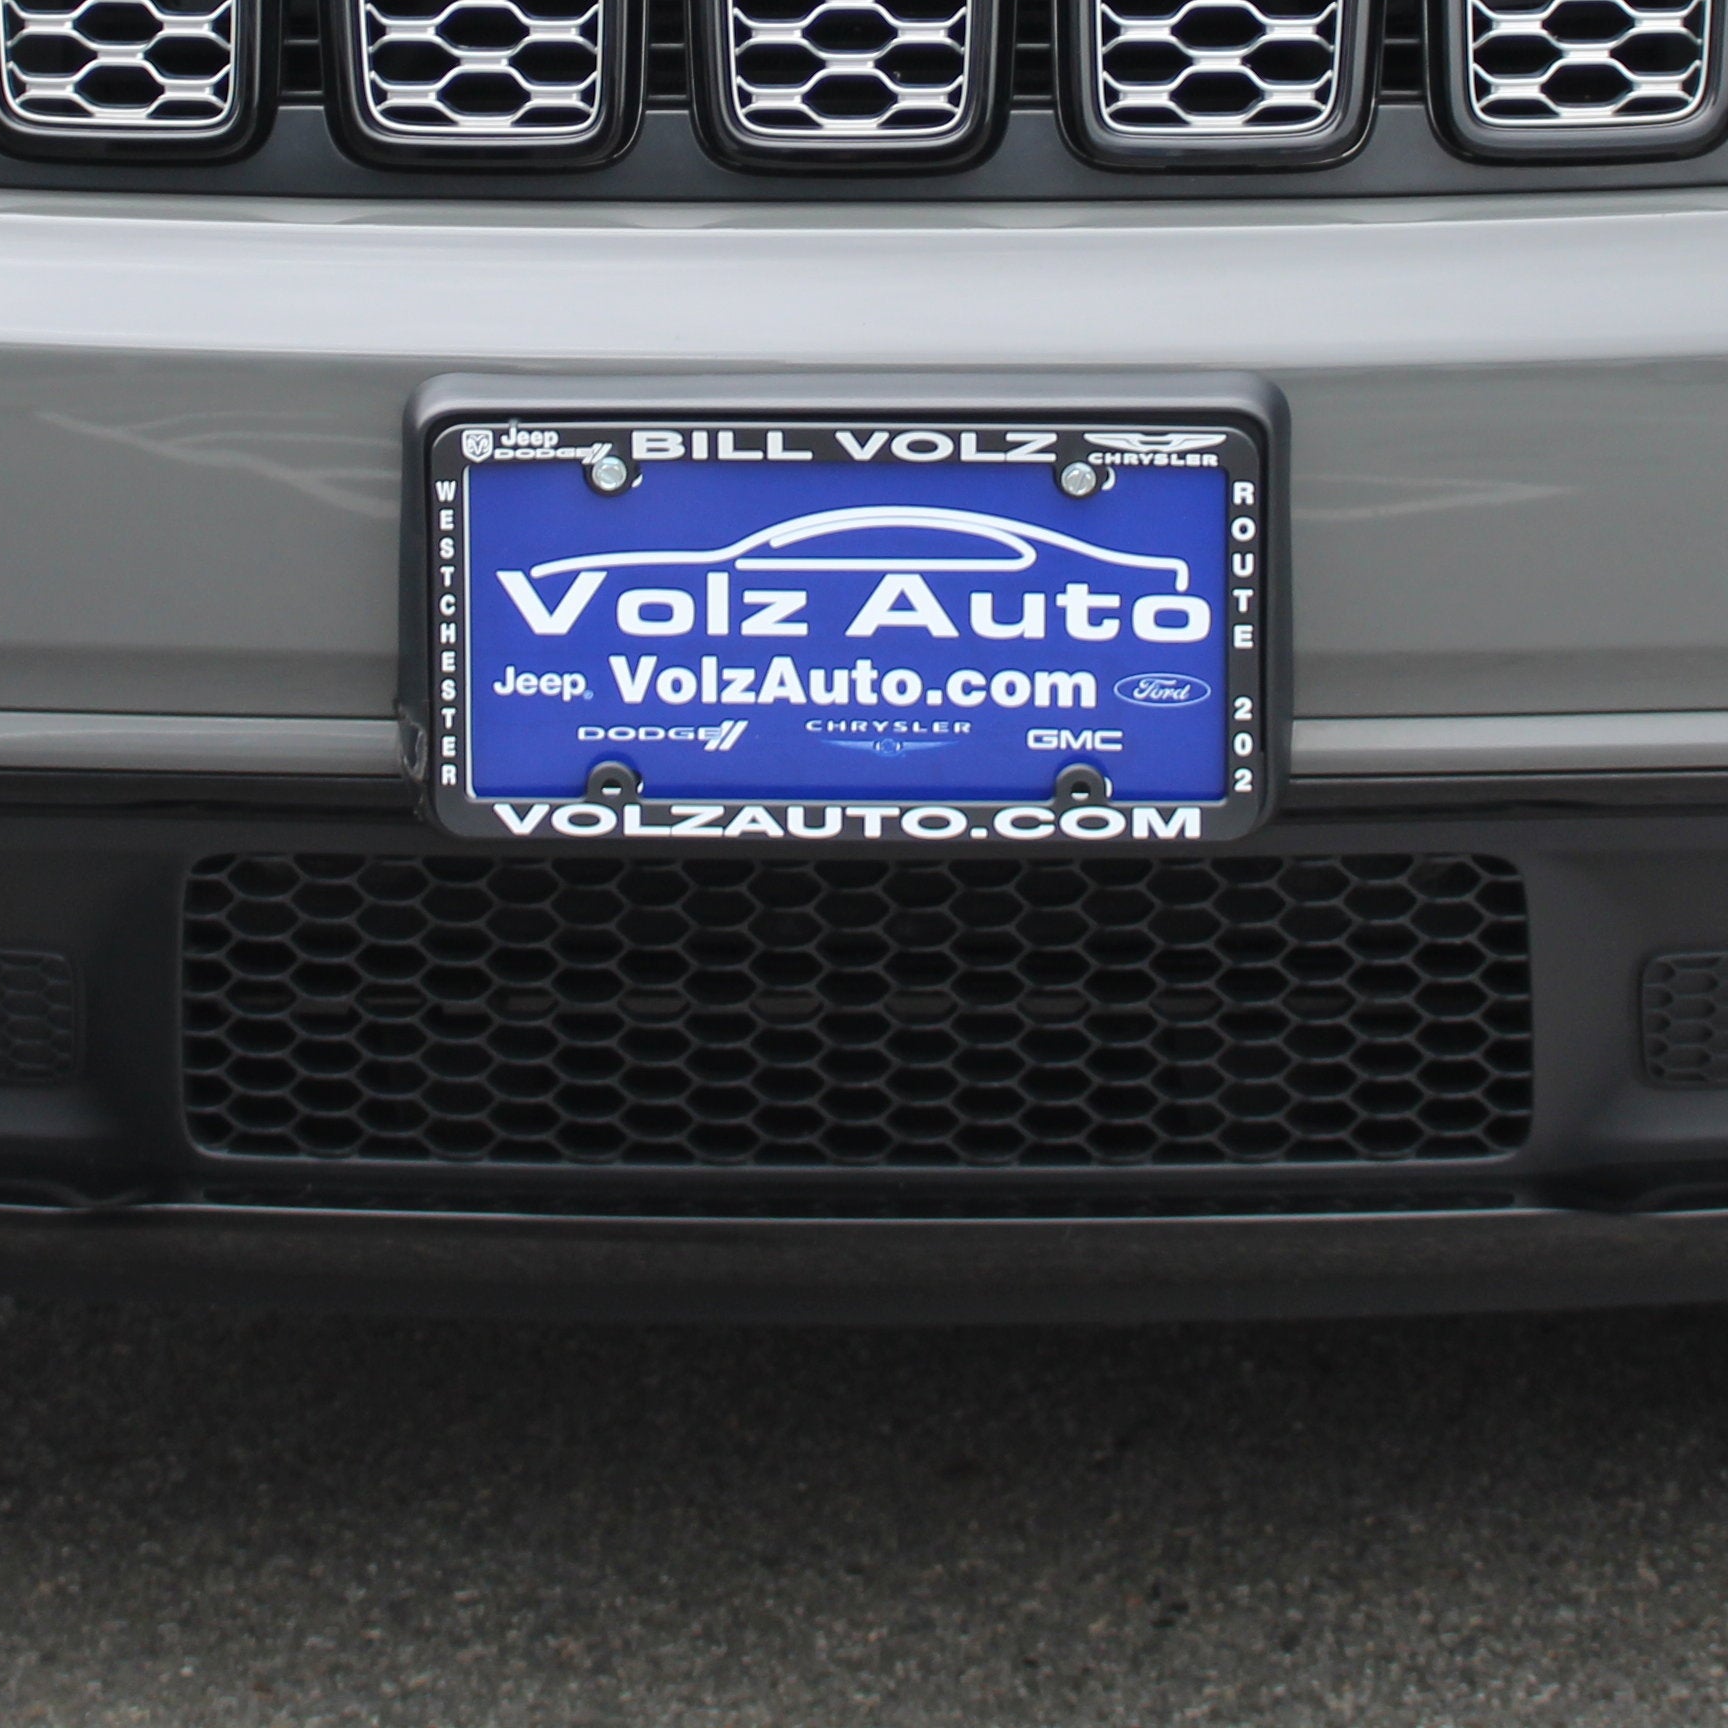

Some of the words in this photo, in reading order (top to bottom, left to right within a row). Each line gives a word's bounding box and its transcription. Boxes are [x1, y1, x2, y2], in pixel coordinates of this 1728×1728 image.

[493, 446, 595, 461] DODGE
[500, 424, 559, 449] Jeep
[632, 429, 813, 460] BILL
[836, 431, 1058, 462] VOLZ
[1087, 451, 1219, 467] CHRYSLER
[1231, 481, 1256, 649] ROUTE
[495, 570, 809, 637] Volz
[844, 573, 1212, 643] Auto
[435, 480, 456, 786] WESTCHESTER
[492, 665, 587, 702] Jeep
[607, 655, 1097, 709] VolzAuto.com
[577, 726, 722, 741] DODGE
[804, 719, 972, 734] CHRYSLER
[1026, 728, 1124, 751] GMC
[1233, 697, 1253, 792] 202
[492, 804, 1203, 840] VOLZAUTO.COM
